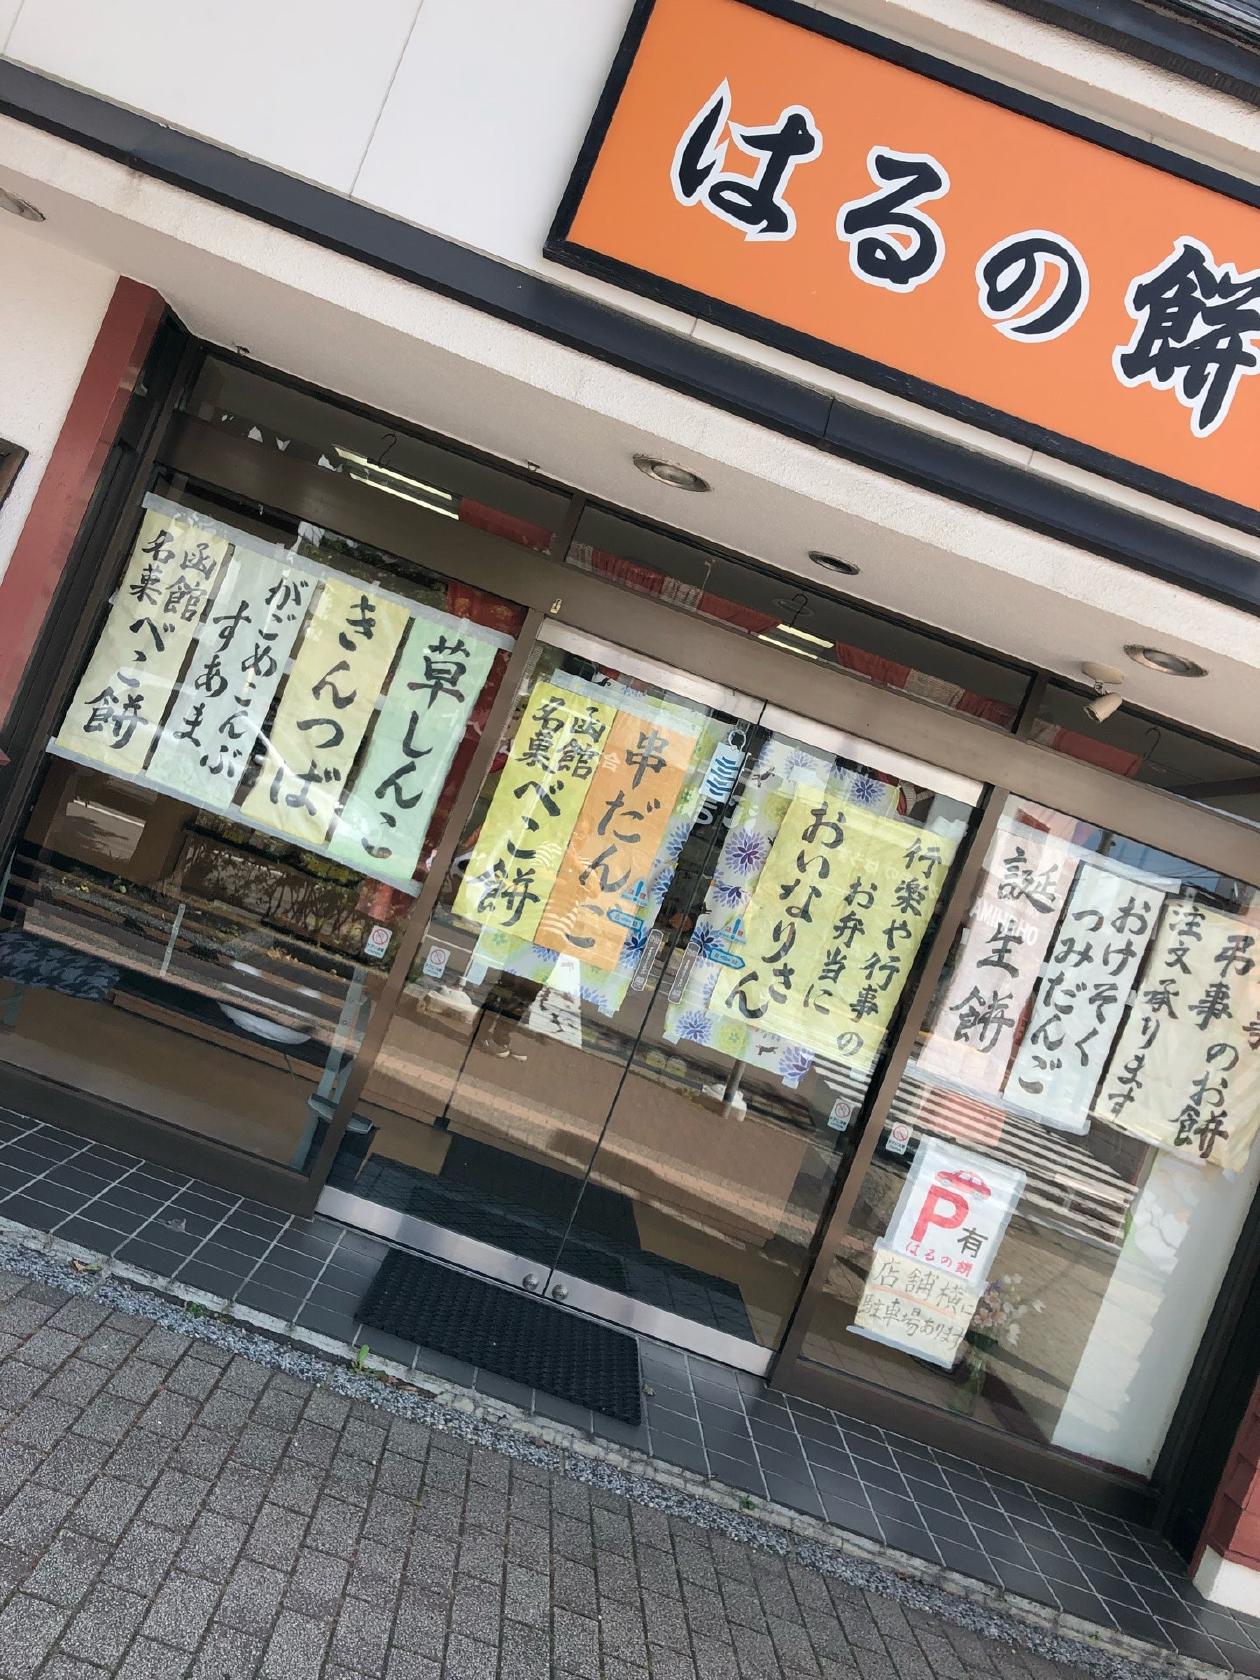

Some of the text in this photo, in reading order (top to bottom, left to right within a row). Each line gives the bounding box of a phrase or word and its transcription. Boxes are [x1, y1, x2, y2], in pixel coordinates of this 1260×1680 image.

[671, 78, 1260, 437] はるの餅
[174, 601, 251, 748] すあま
[201, 577, 308, 779] がごめこんぶ
[269, 595, 376, 816] きんつば
[362, 635, 470, 859] 草しんこ
[725, 801, 846, 1019] おいなりさん
[803, 876, 878, 1015] お弁当に
[836, 837, 943, 1056] 行楽や行事の
[950, 846, 1056, 1053] 誕生餅
[1018, 908, 1105, 1095] つみだんご
[1075, 896, 1151, 1066] おけそく
[1108, 904, 1206, 1120] 注文承ります
[873, 1257, 975, 1316] 店舗横に
[911, 1184, 970, 1242] P
[957, 1227, 989, 1258] 有
